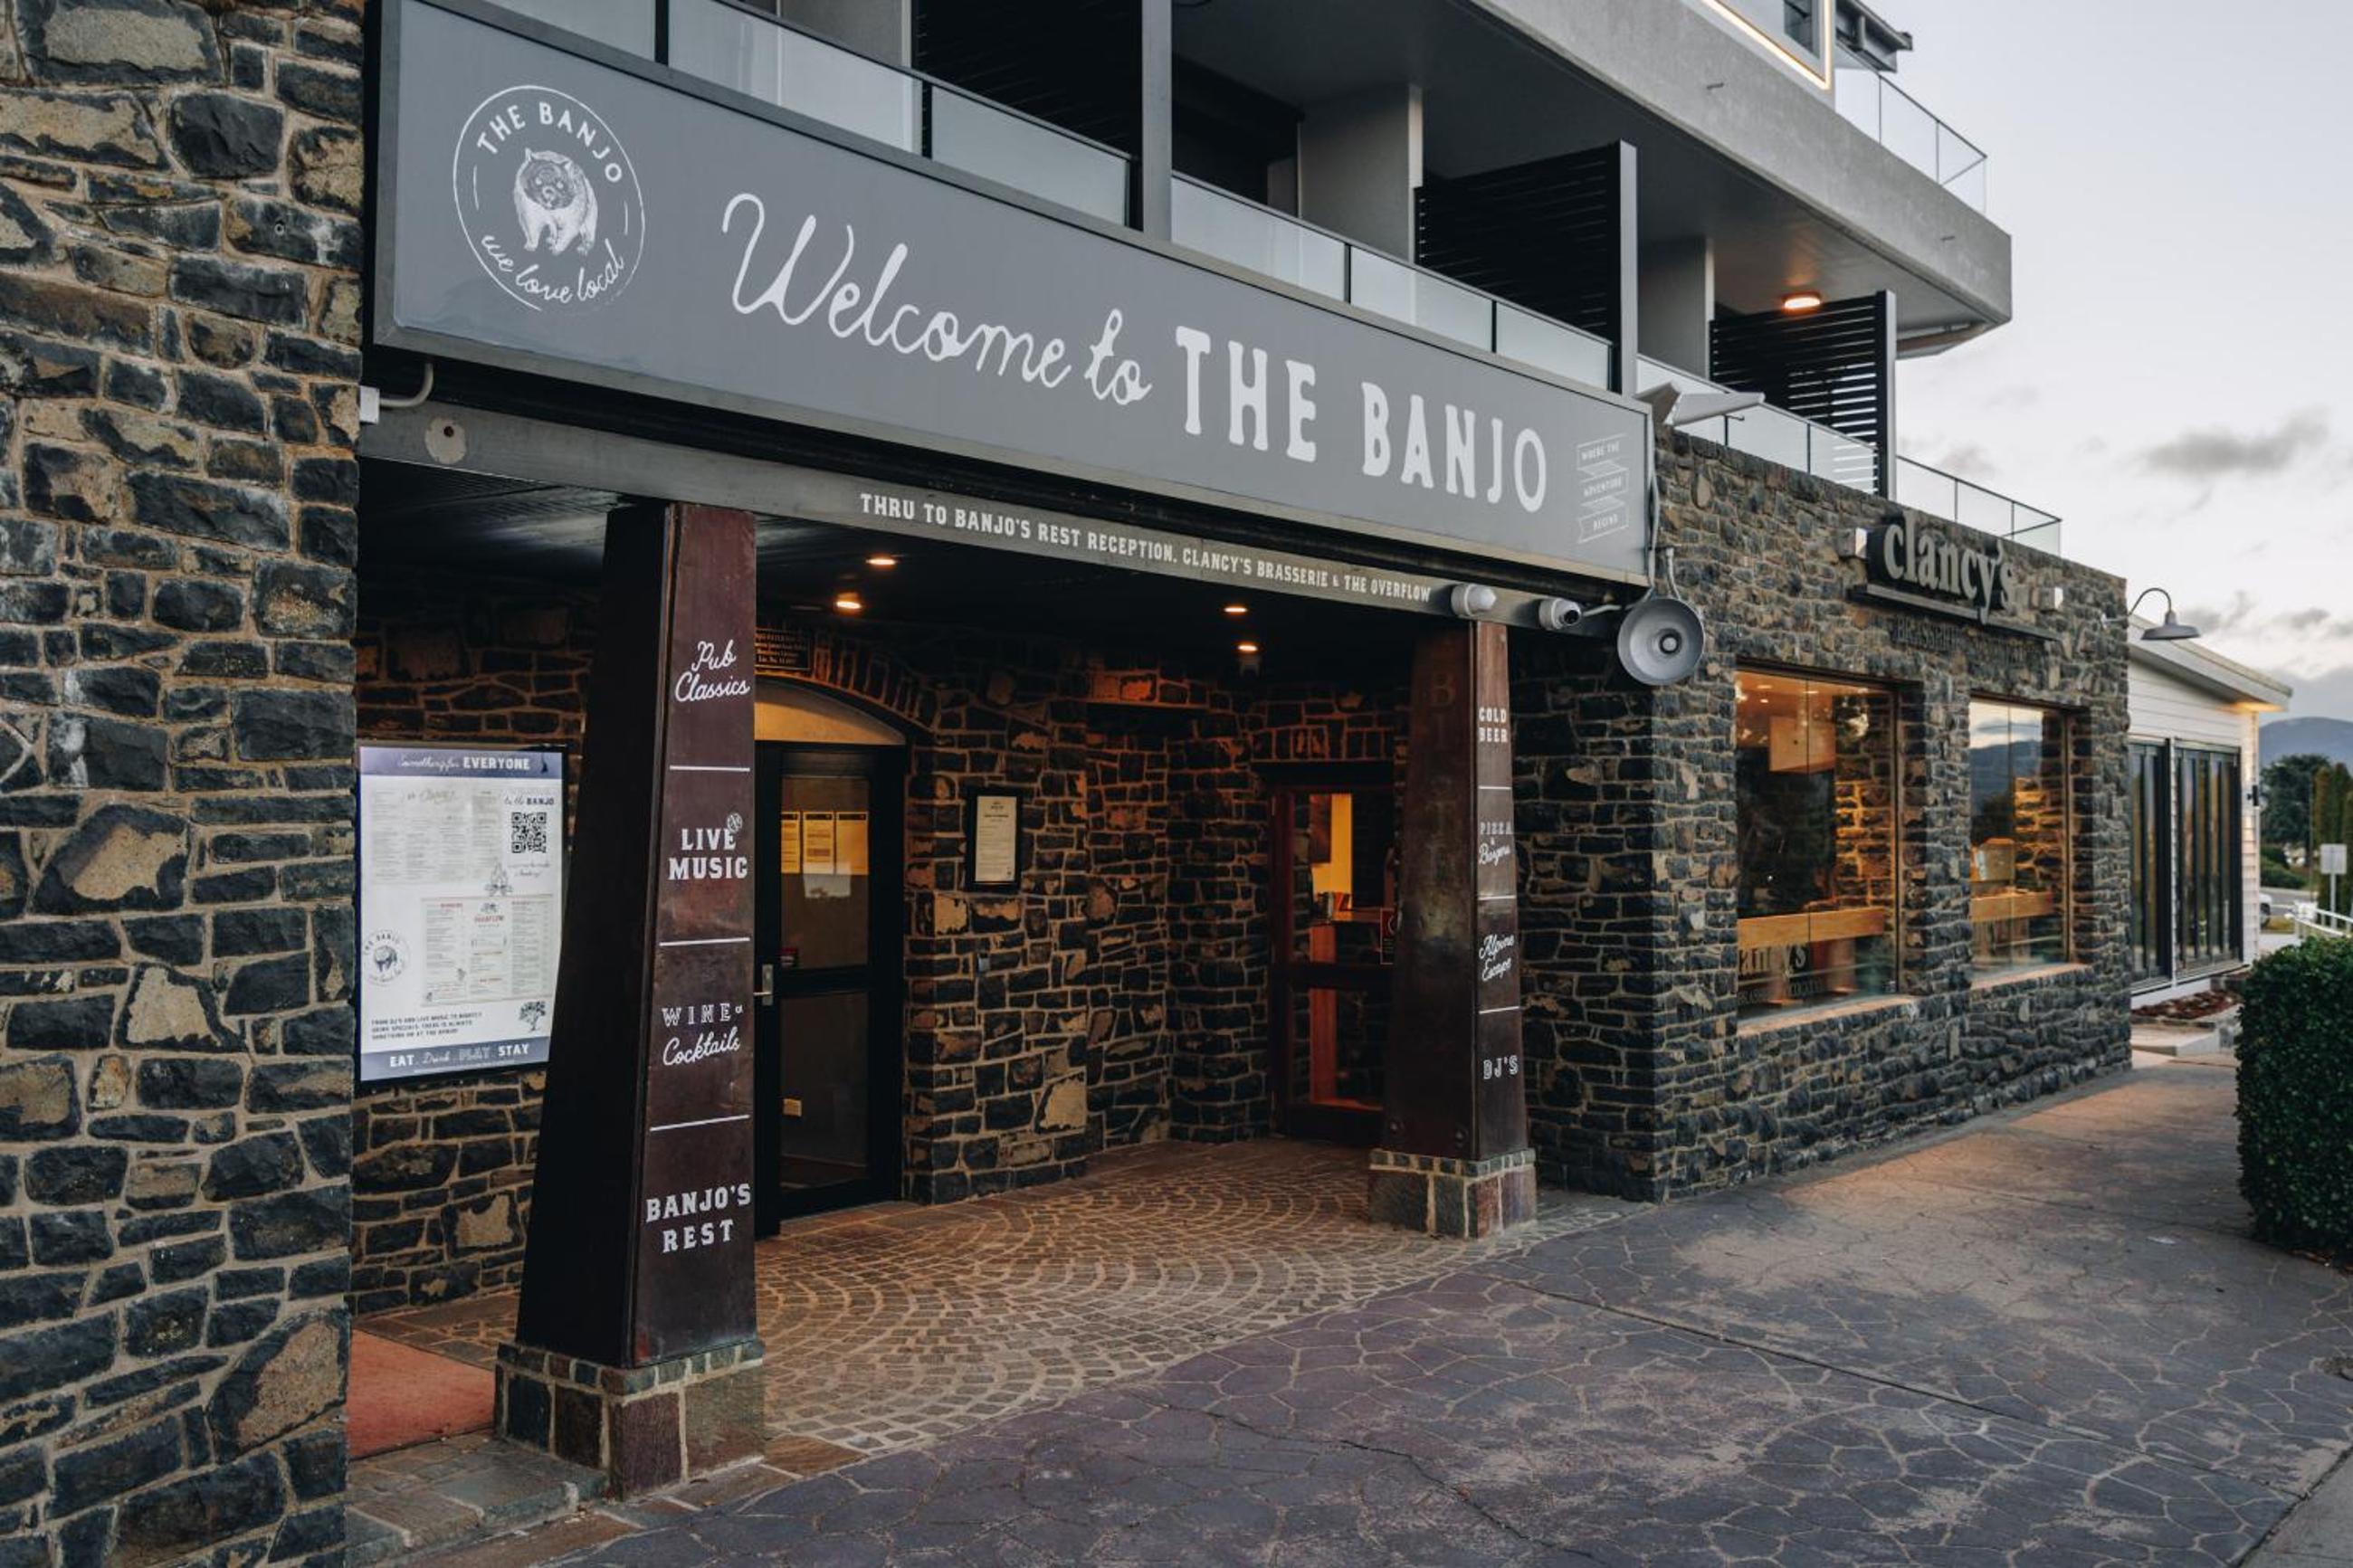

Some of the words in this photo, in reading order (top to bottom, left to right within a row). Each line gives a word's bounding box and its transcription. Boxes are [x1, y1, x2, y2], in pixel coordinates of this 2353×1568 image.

[478, 104, 526, 155] THE
[539, 101, 623, 183] BANJO
[481, 234, 514, 273] we
[516, 263, 573, 303] love
[577, 237, 626, 302] local
[722, 193, 1072, 389] Welcome
[1083, 309, 1153, 406] to
[1176, 326, 1318, 462] THE
[1361, 381, 1548, 513] BANJO
[861, 493, 915, 520] THRU
[923, 503, 948, 526] TO
[955, 508, 1031, 539] BANJO'S
[1038, 522, 1081, 547] REST
[1182, 546, 1253, 575] CLANCY'S
[1257, 559, 1329, 588] BRASSERIE
[1344, 575, 1367, 594] THE
[1370, 577, 1432, 603] OVERFLOW
[1883, 509, 2018, 625] clancy's
[691, 639, 737, 672] Pub
[674, 671, 750, 702] Classics
[1478, 707, 1508, 723] COLD
[1478, 727, 1509, 743] BEER
[462, 756, 530, 771] EVERYONE
[526, 796, 555, 805] BANJO
[681, 827, 737, 851] LIVE
[668, 857, 748, 880] MUSIC
[662, 1003, 732, 1028] WINE
[389, 1054, 414, 1068] EAT
[498, 1044, 529, 1057] STAY
[662, 1026, 741, 1066] Cocktails
[1483, 1055, 1519, 1079] DJ'S
[646, 1183, 751, 1222] BANJO'S
[662, 1219, 735, 1254] REST
